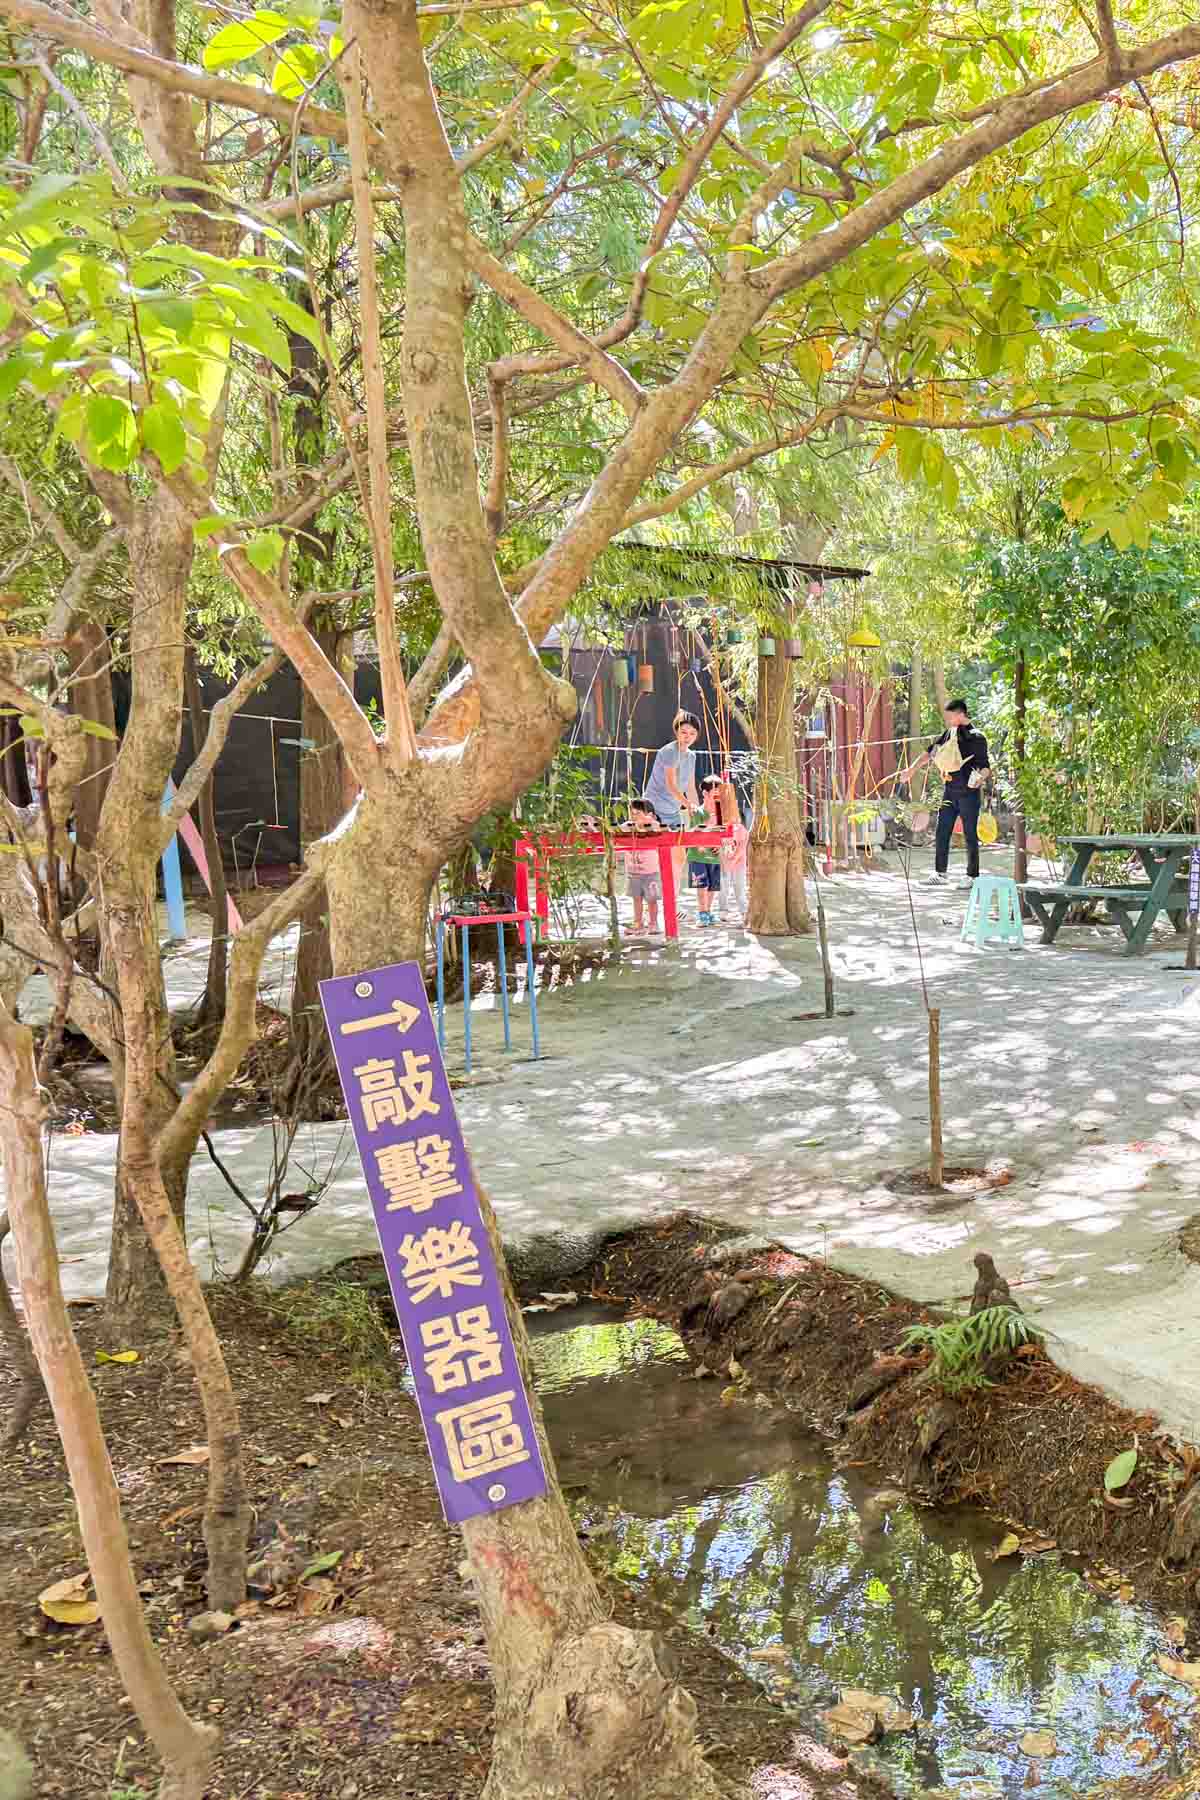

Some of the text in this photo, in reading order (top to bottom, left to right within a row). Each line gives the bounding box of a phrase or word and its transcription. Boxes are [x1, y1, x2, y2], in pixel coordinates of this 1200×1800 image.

[353, 1050, 530, 1482] 敲擊樂器區
